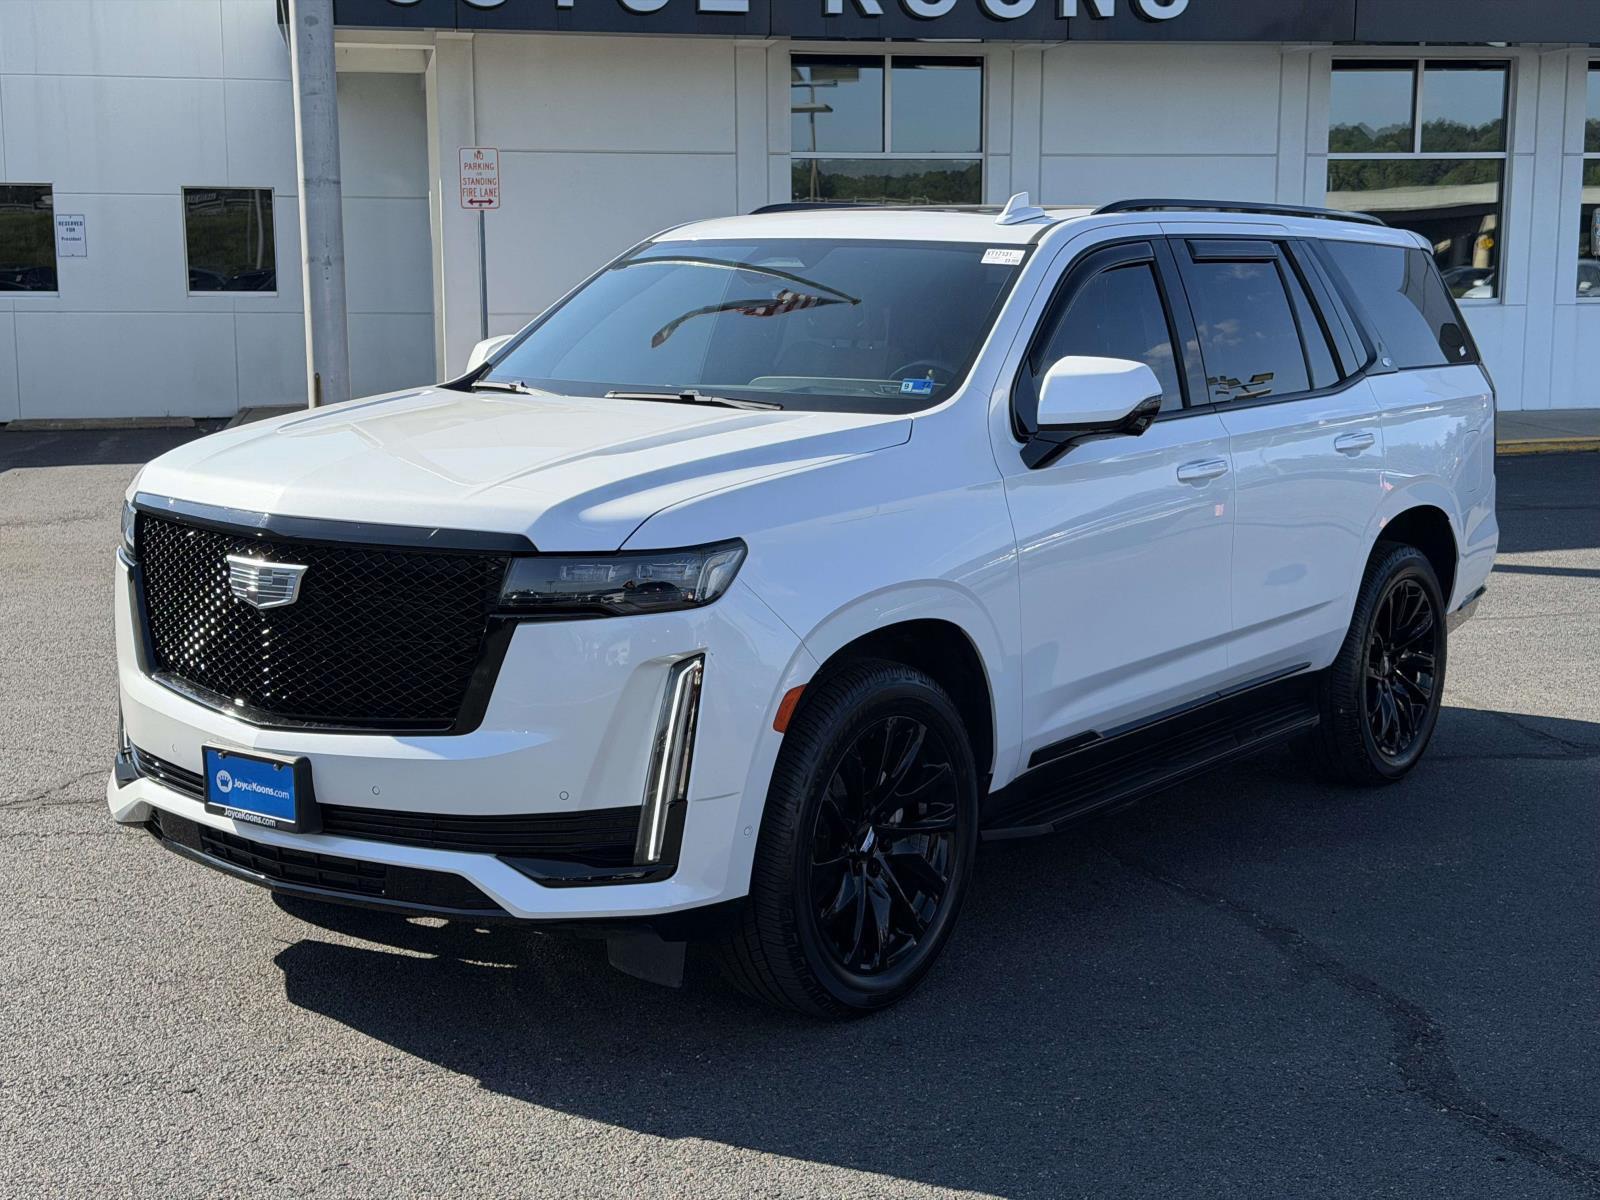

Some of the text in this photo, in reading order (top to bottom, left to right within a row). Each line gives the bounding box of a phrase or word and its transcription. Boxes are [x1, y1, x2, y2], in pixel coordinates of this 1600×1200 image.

[474, 150, 484, 160] NO
[464, 162, 494, 170] PARKING
[462, 178, 497, 186] STANDING
[462, 188, 498, 198] FIRE LANE
[234, 778, 290, 800] JoyceKoons.com
[224, 807, 276, 827] JoyceKoons.com
